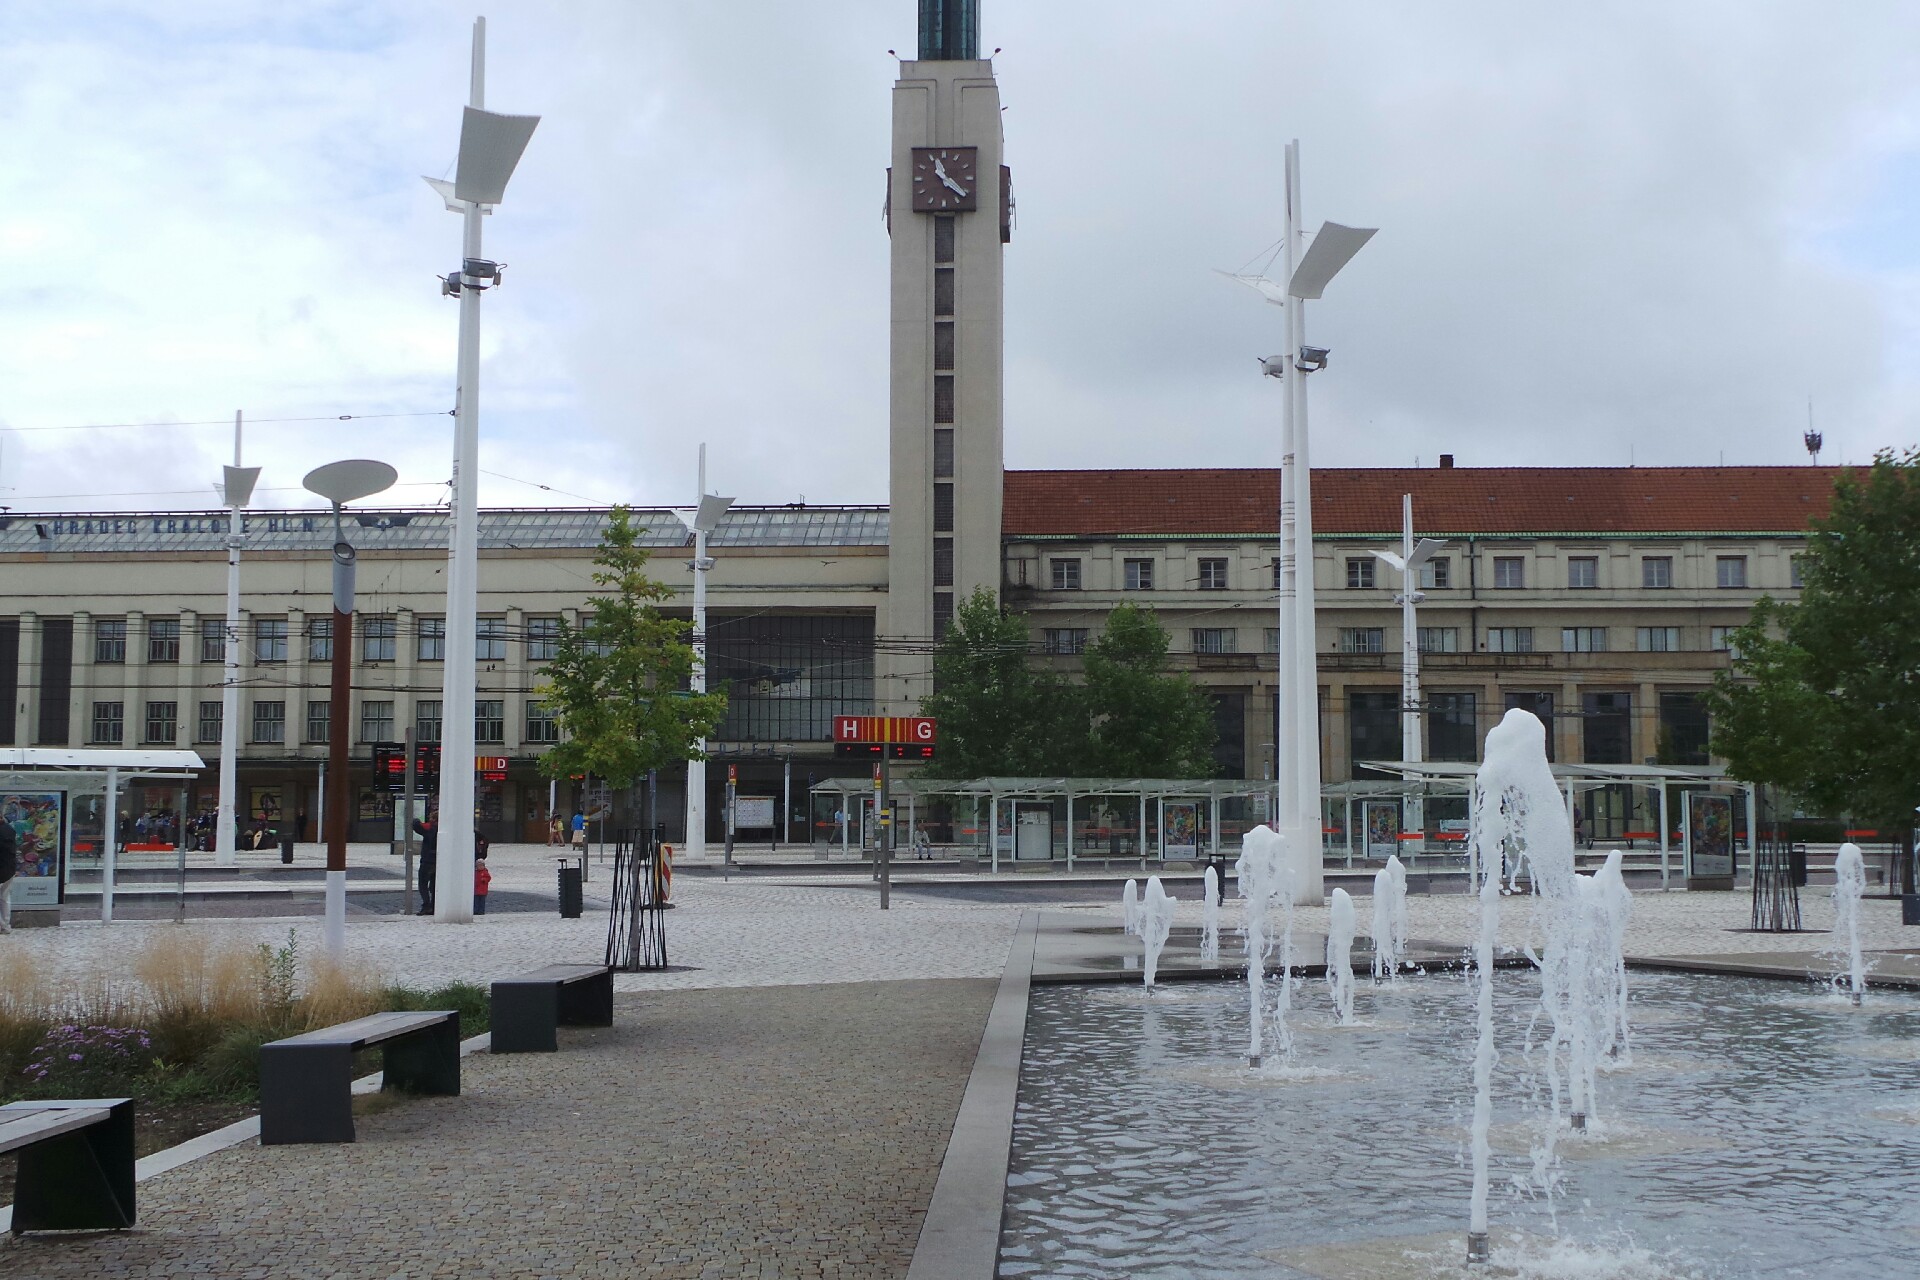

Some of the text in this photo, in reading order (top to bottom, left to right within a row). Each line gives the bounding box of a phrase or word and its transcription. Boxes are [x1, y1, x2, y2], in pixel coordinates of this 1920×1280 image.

[54, 519, 137, 535] HRADEC
[843, 720, 857, 739] H
[917, 721, 932, 739] G
[497, 758, 506, 769] D
